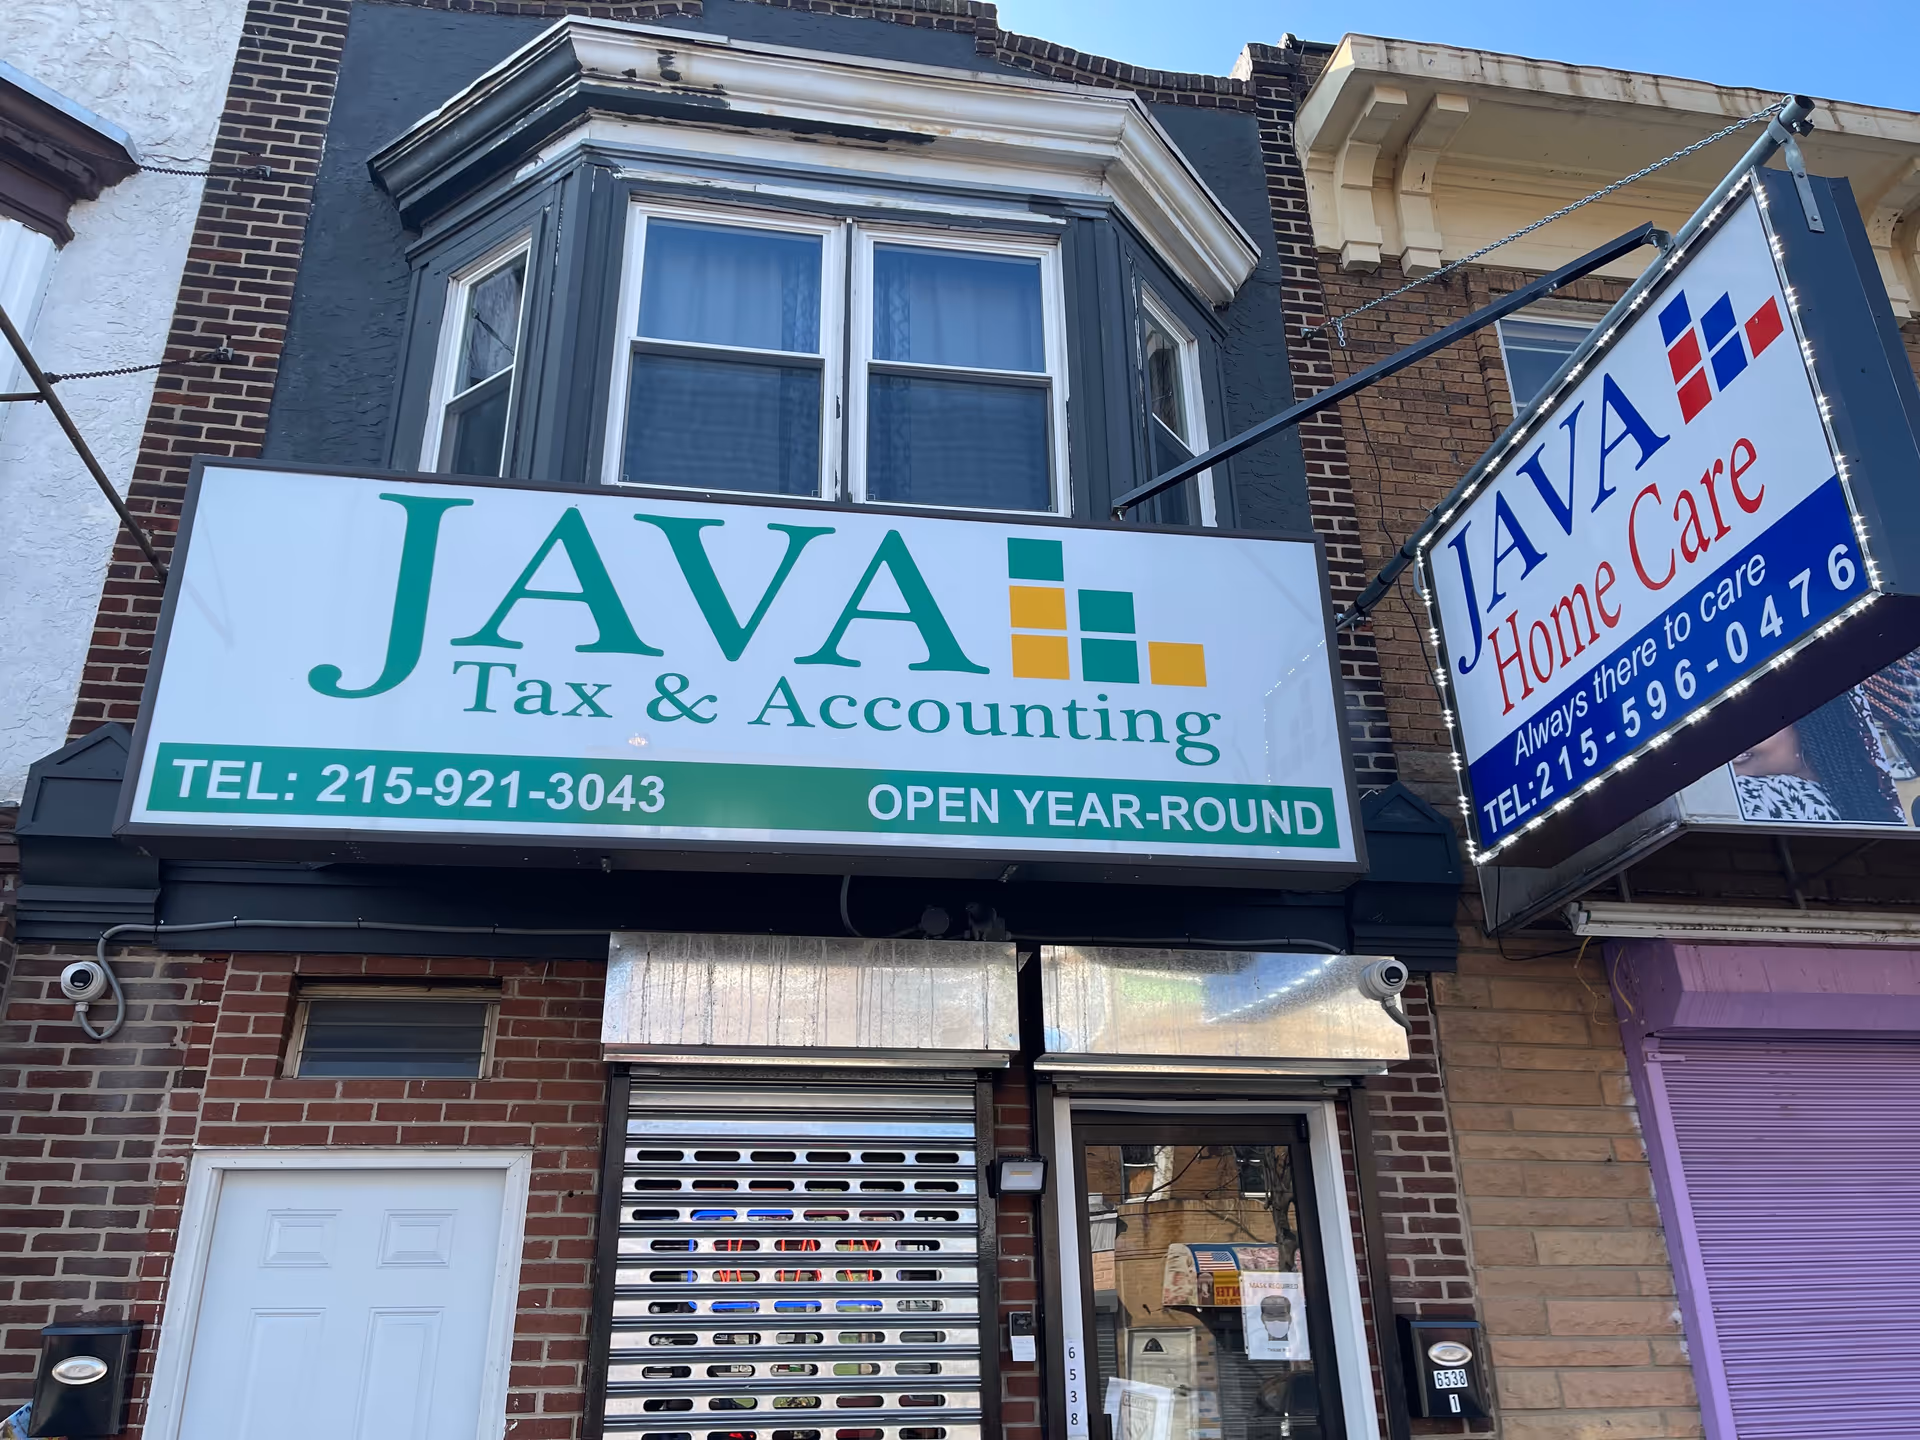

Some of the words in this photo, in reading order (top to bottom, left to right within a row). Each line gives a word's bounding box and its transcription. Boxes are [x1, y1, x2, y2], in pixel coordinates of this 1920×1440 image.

[309, 493, 989, 699] JAVA
[1448, 372, 1671, 674] JAVA
[1487, 560, 1622, 716] Home
[1628, 437, 1765, 591] Care
[452, 660, 613, 719] Tax
[646, 672, 718, 724] &
[747, 675, 1222, 766] Accounting
[1514, 687, 1588, 766] Always
[1592, 639, 1658, 706] there
[1664, 611, 1692, 652] to
[1700, 554, 1767, 625] care
[172, 758, 298, 802] TEL:
[316, 763, 667, 813] 215-921-3043
[867, 783, 999, 824] OPEN
[1014, 788, 1325, 836] YEAR-ROUND
[1436, 1370, 1465, 1387] 6538
